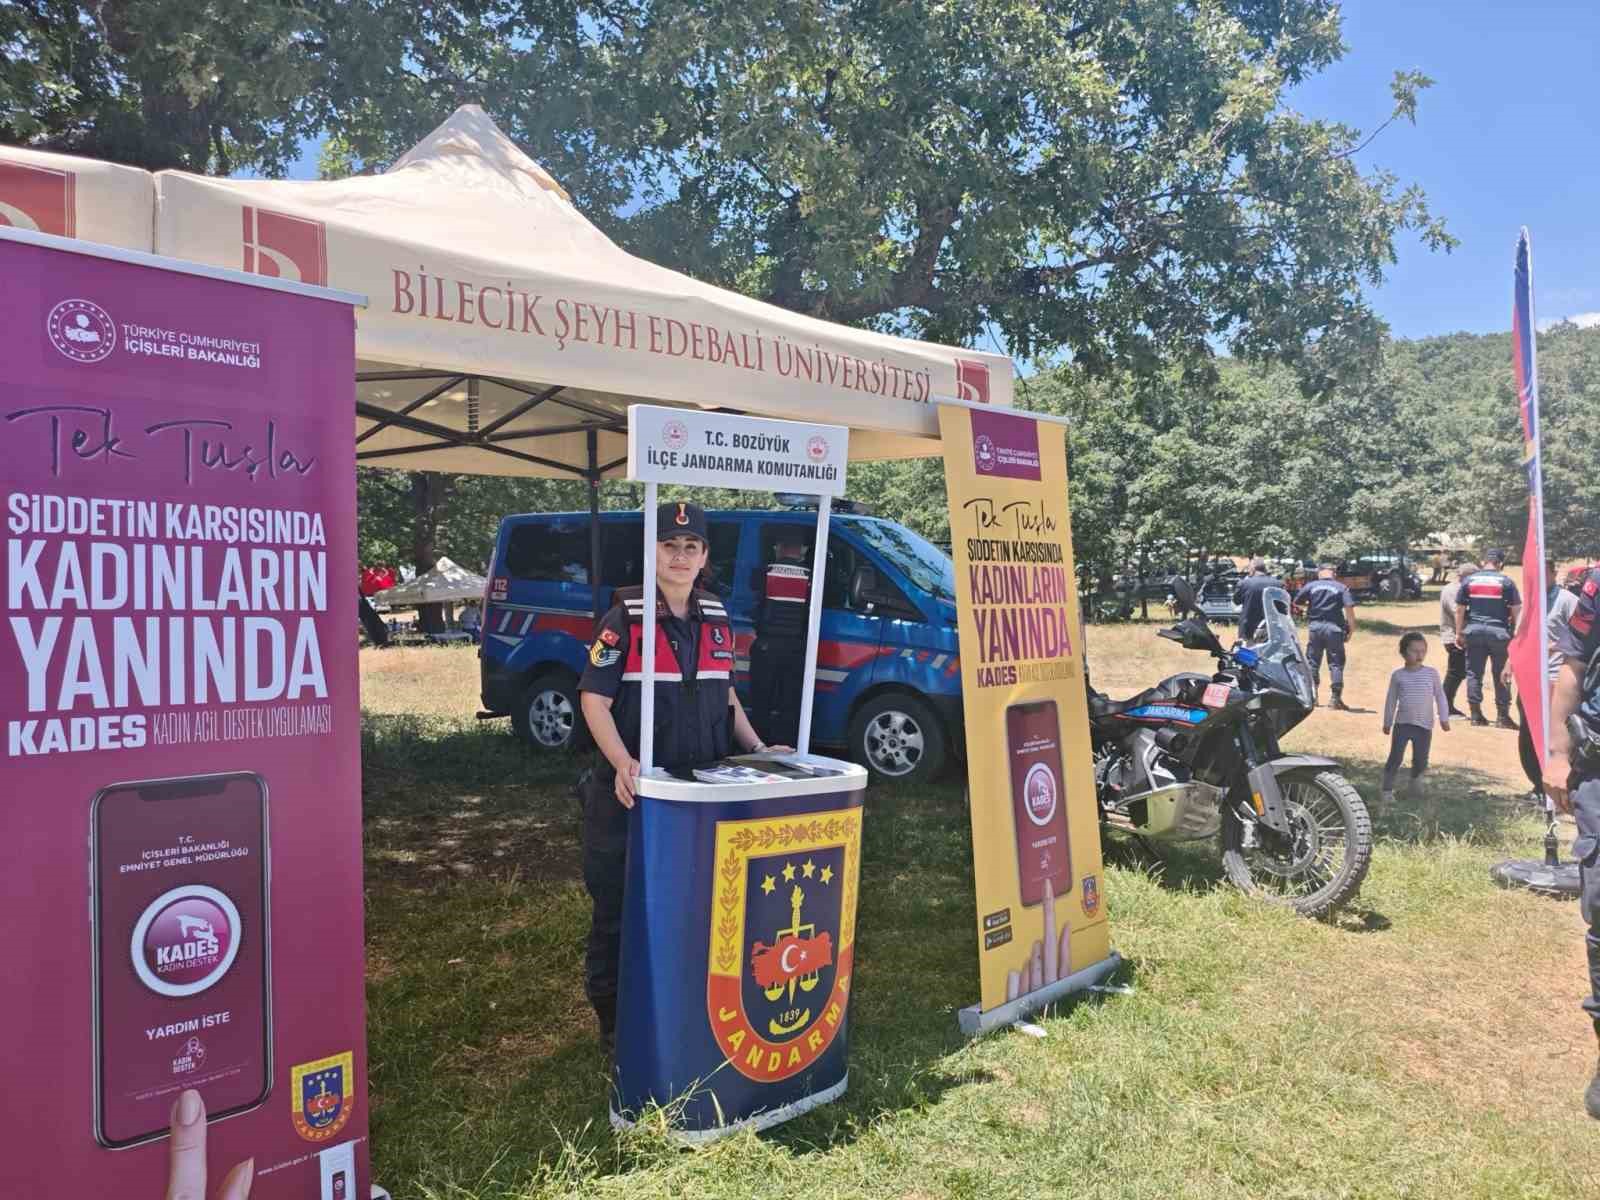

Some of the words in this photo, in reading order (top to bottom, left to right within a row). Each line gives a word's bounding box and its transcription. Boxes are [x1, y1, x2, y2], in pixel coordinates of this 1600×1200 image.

[122, 324, 176, 342] TÜRKİYE
[179, 333, 260, 354] CUMHURİYETİ
[125, 337, 184, 358] İÇİŞLERİ
[188, 347, 260, 368] BAKANLIĞI
[392, 264, 544, 336] BİLECİK
[554, 299, 637, 351] ŞEYH
[648, 316, 765, 371] EDEBALİ
[775, 335, 932, 406] ÜNİVERSİTESİ
[5, 406, 136, 477] Tek
[145, 419, 316, 484] Tuşla
[647, 446, 678, 469] İLÇE
[681, 453, 753, 474] JANDARMA
[757, 461, 838, 481] KOMUTANLIĞI
[705, 430, 728, 447] T.C.
[733, 433, 790, 453] BOZÜYÜK
[8, 492, 157, 538] ŞİDDETİN
[165, 503, 326, 546] KARŞISINDA
[8, 539, 327, 611] KADINLARIN
[969, 564, 1067, 605] KADINLARIN
[972, 607, 1072, 663] YANINDA
[9, 616, 328, 712] YANINDA
[976, 665, 1017, 688] KADES
[8, 714, 147, 757] KADES
[151, 710, 192, 745] KADIN
[194, 709, 221, 743] ACİL
[223, 708, 265, 741] DESTEK
[267, 703, 333, 738] UYGULAMASI
[157, 939, 219, 966] KADES
[145, 1020, 199, 1041] YARDIM
[202, 1011, 232, 1030] İSTE
[718, 975, 850, 1073] JANDARMA
